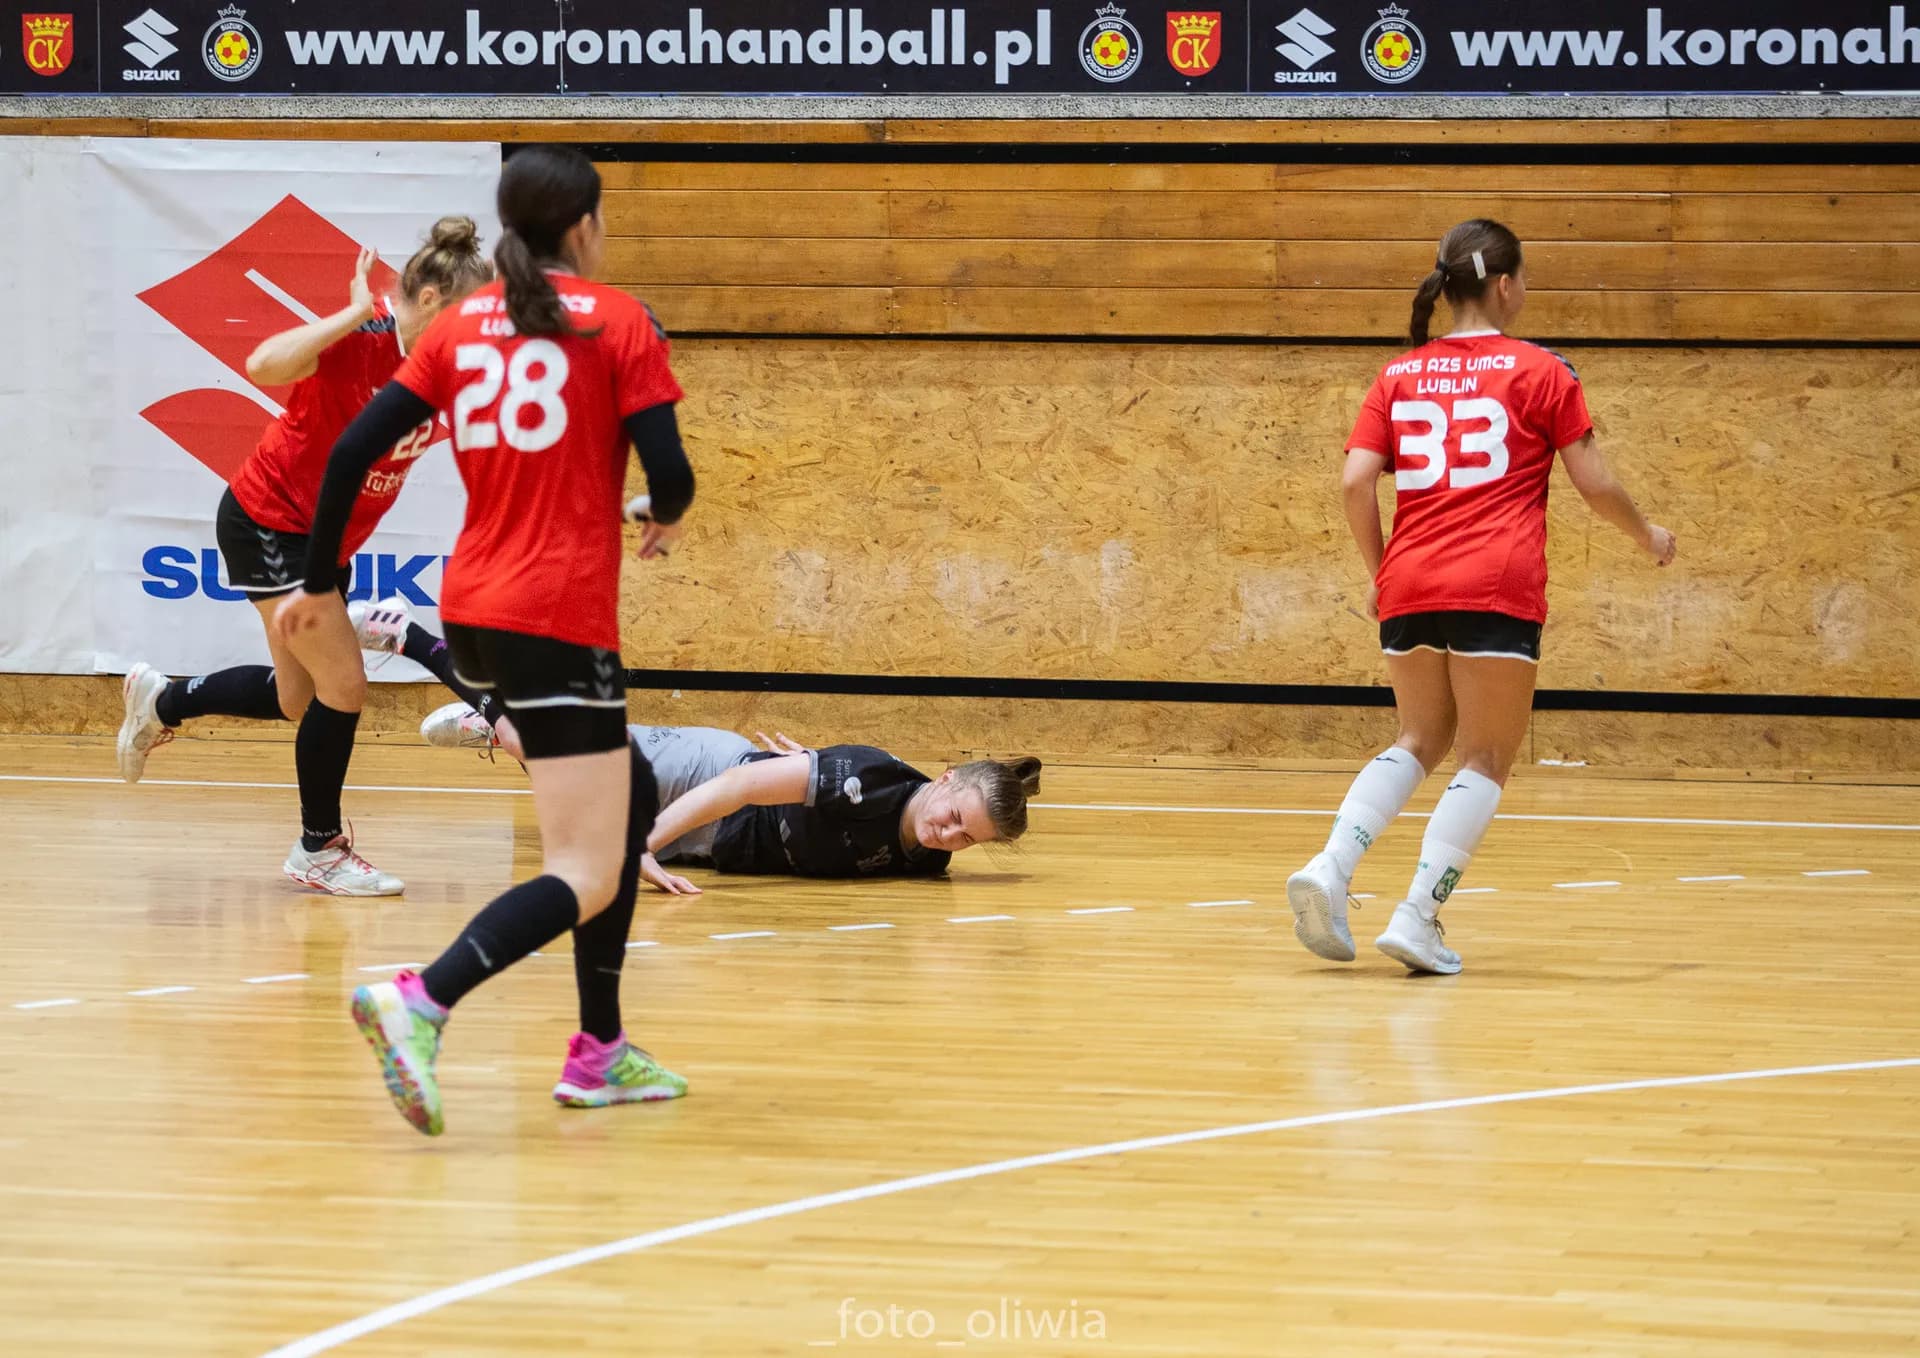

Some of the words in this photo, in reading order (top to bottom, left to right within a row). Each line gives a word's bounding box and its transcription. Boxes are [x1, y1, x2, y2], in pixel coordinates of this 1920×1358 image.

[28, 38, 63, 69] CK
[285, 9, 1051, 84] www.koronahandball.pl
[1172, 37, 1210, 69] CK
[123, 70, 180, 81] SUZUKI
[1274, 72, 1336, 83] SUZUKI
[1386, 359, 1422, 376] MKS
[1427, 357, 1461, 373] AZS
[1466, 355, 1517, 371] UMCS
[455, 338, 569, 452] 28
[1416, 376, 1478, 394] LUBLIN
[1390, 397, 1510, 491] 33
